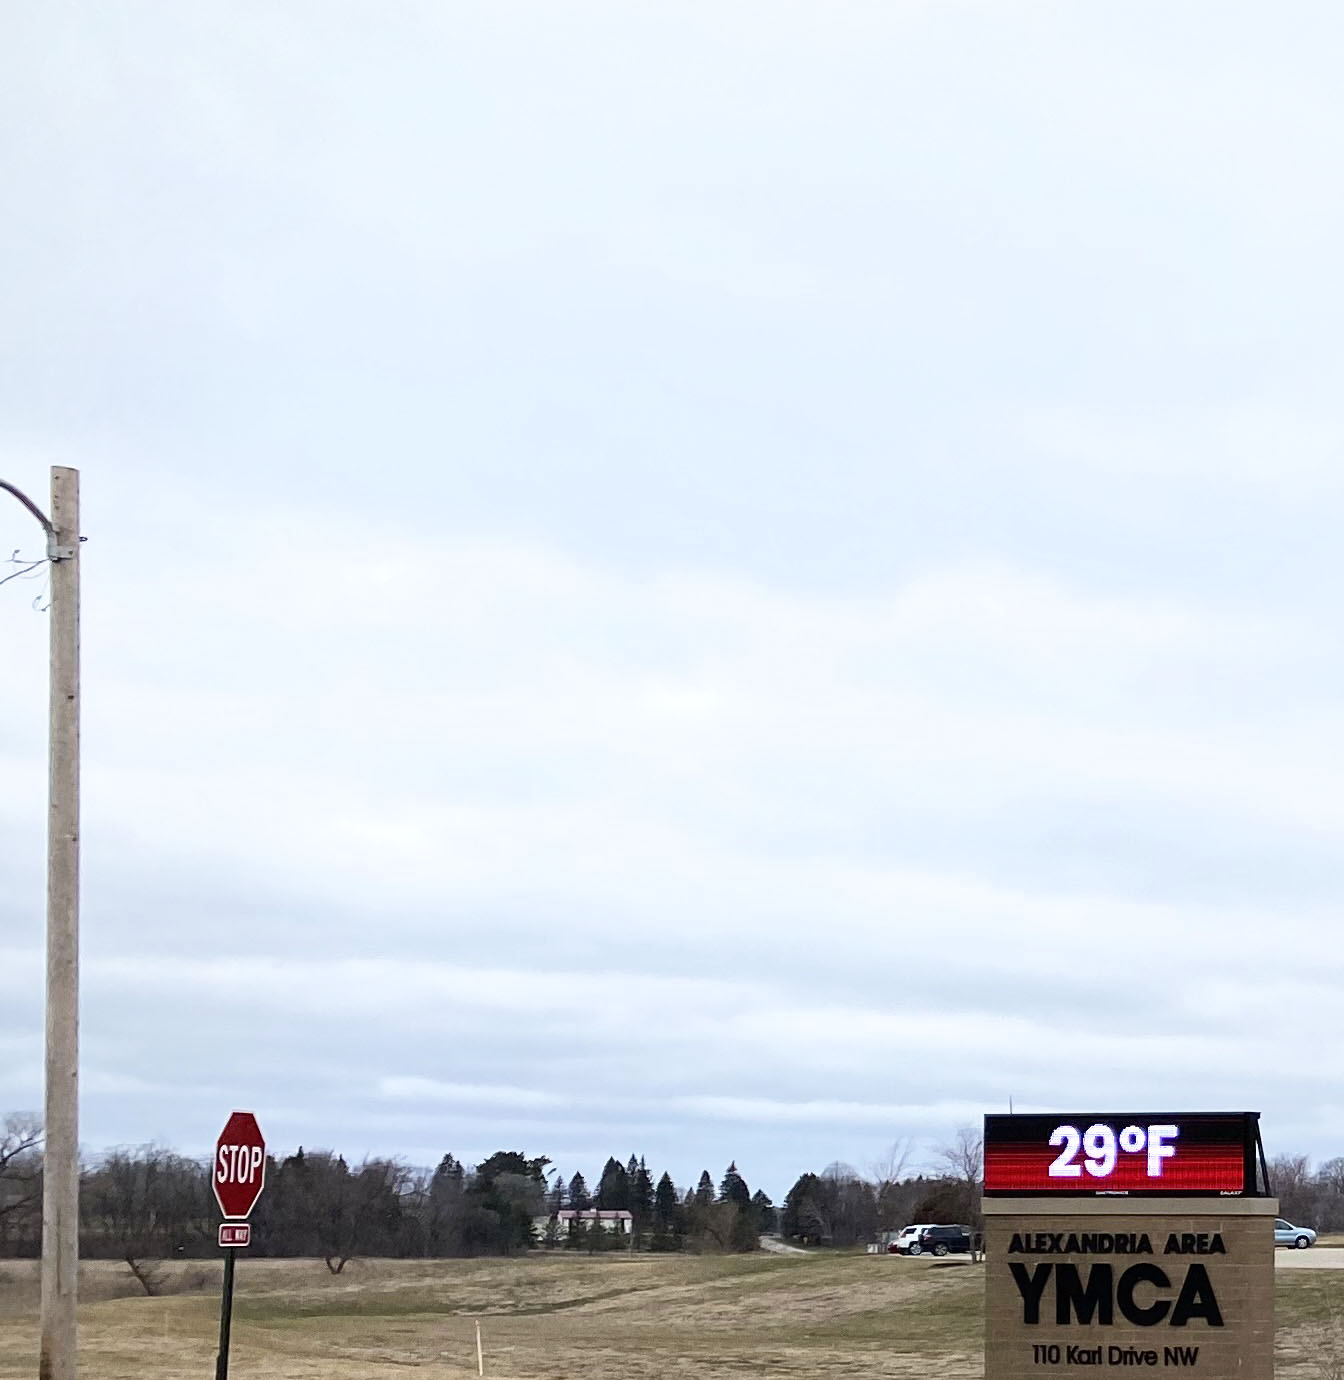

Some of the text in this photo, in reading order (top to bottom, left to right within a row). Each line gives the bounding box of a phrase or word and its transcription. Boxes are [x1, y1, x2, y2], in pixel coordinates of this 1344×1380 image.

[217, 1144, 262, 1184] STOP
[1008, 1233, 1227, 1255] ALEXANDRIA AREA
[1007, 1262, 1225, 1327] YMCA
[1032, 1344, 1200, 1367] 110 Karl Drive NW
